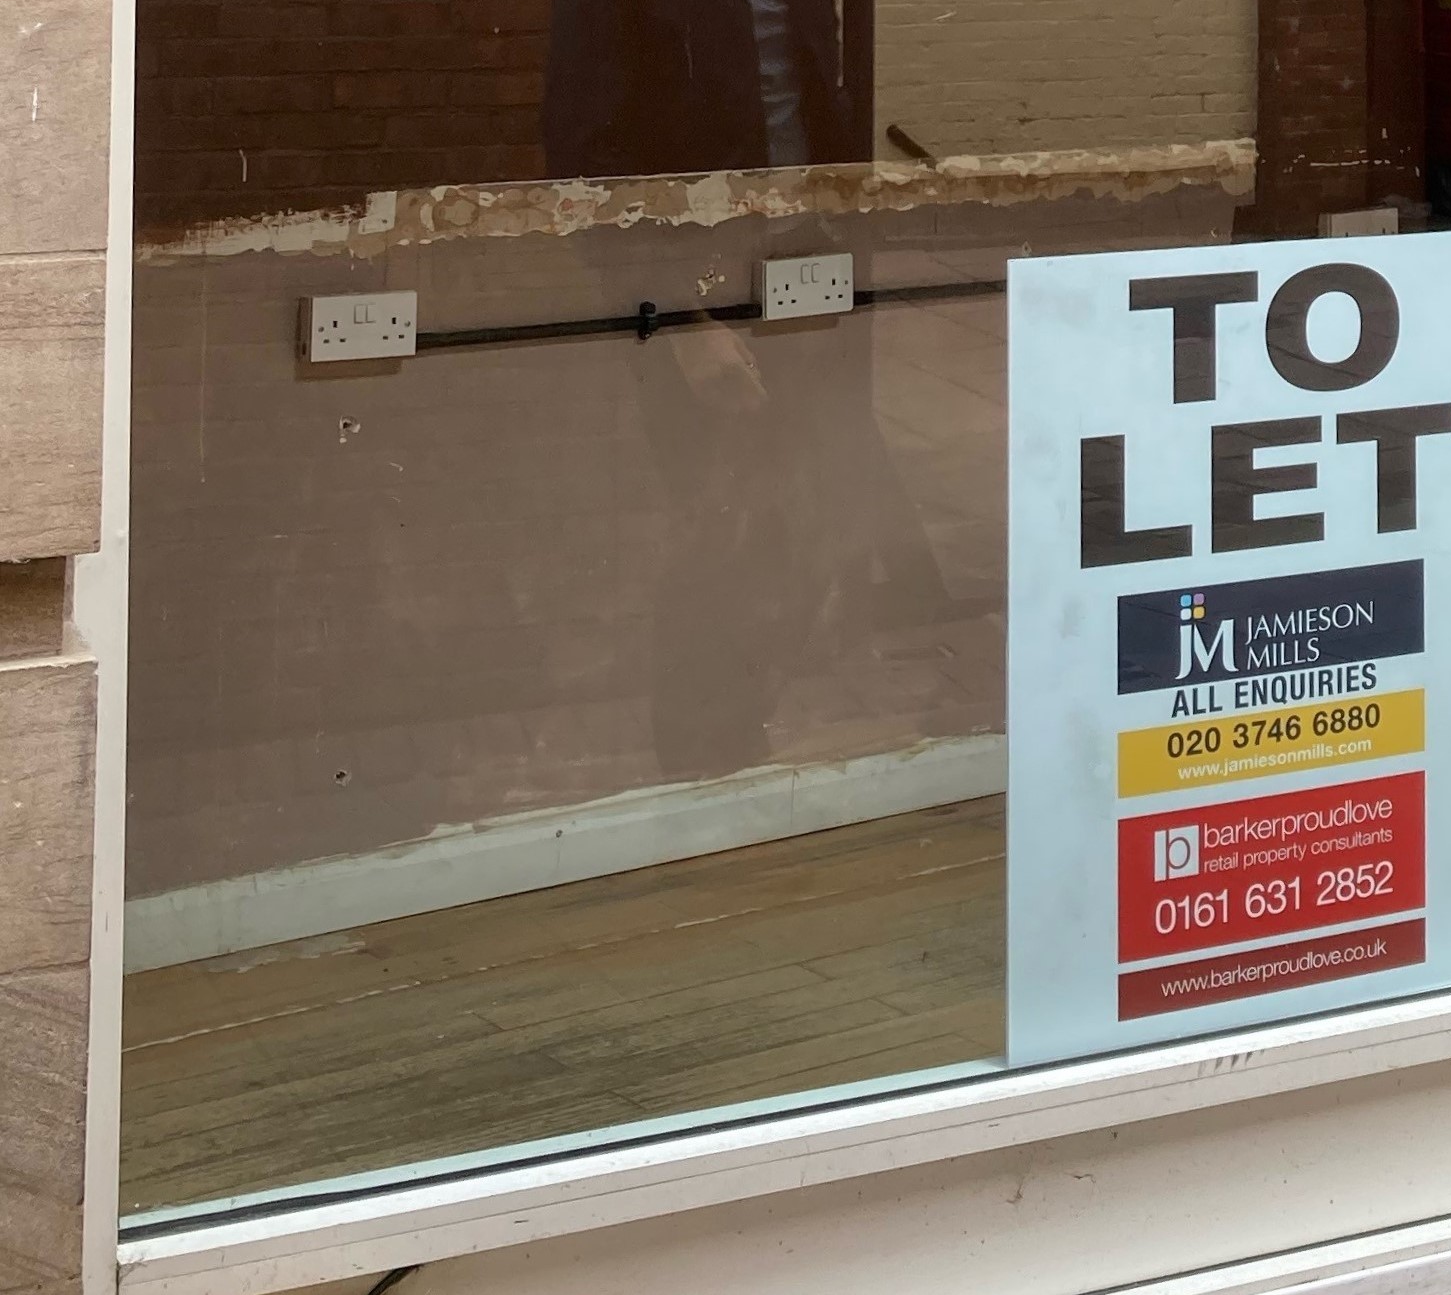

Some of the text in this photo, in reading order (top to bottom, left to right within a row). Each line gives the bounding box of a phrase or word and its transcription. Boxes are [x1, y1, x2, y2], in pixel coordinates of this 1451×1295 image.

[1128, 262, 1400, 404] TO
[1245, 600, 1376, 646] JAMIESON
[1246, 636, 1321, 672] MILLS
[1171, 661, 1378, 719] ALL ENQUIRIES
[1167, 702, 1381, 759] 020 3746 6880
[1177, 737, 1373, 781] www.jamiesonmills.com
[1203, 799, 1394, 849] barkerproudlove
[1203, 827, 1393, 874] retail property consultants
[1154, 860, 1394, 935] 0161 631 2852
[1161, 937, 1388, 998] www.barkerproudlove.co.uk
